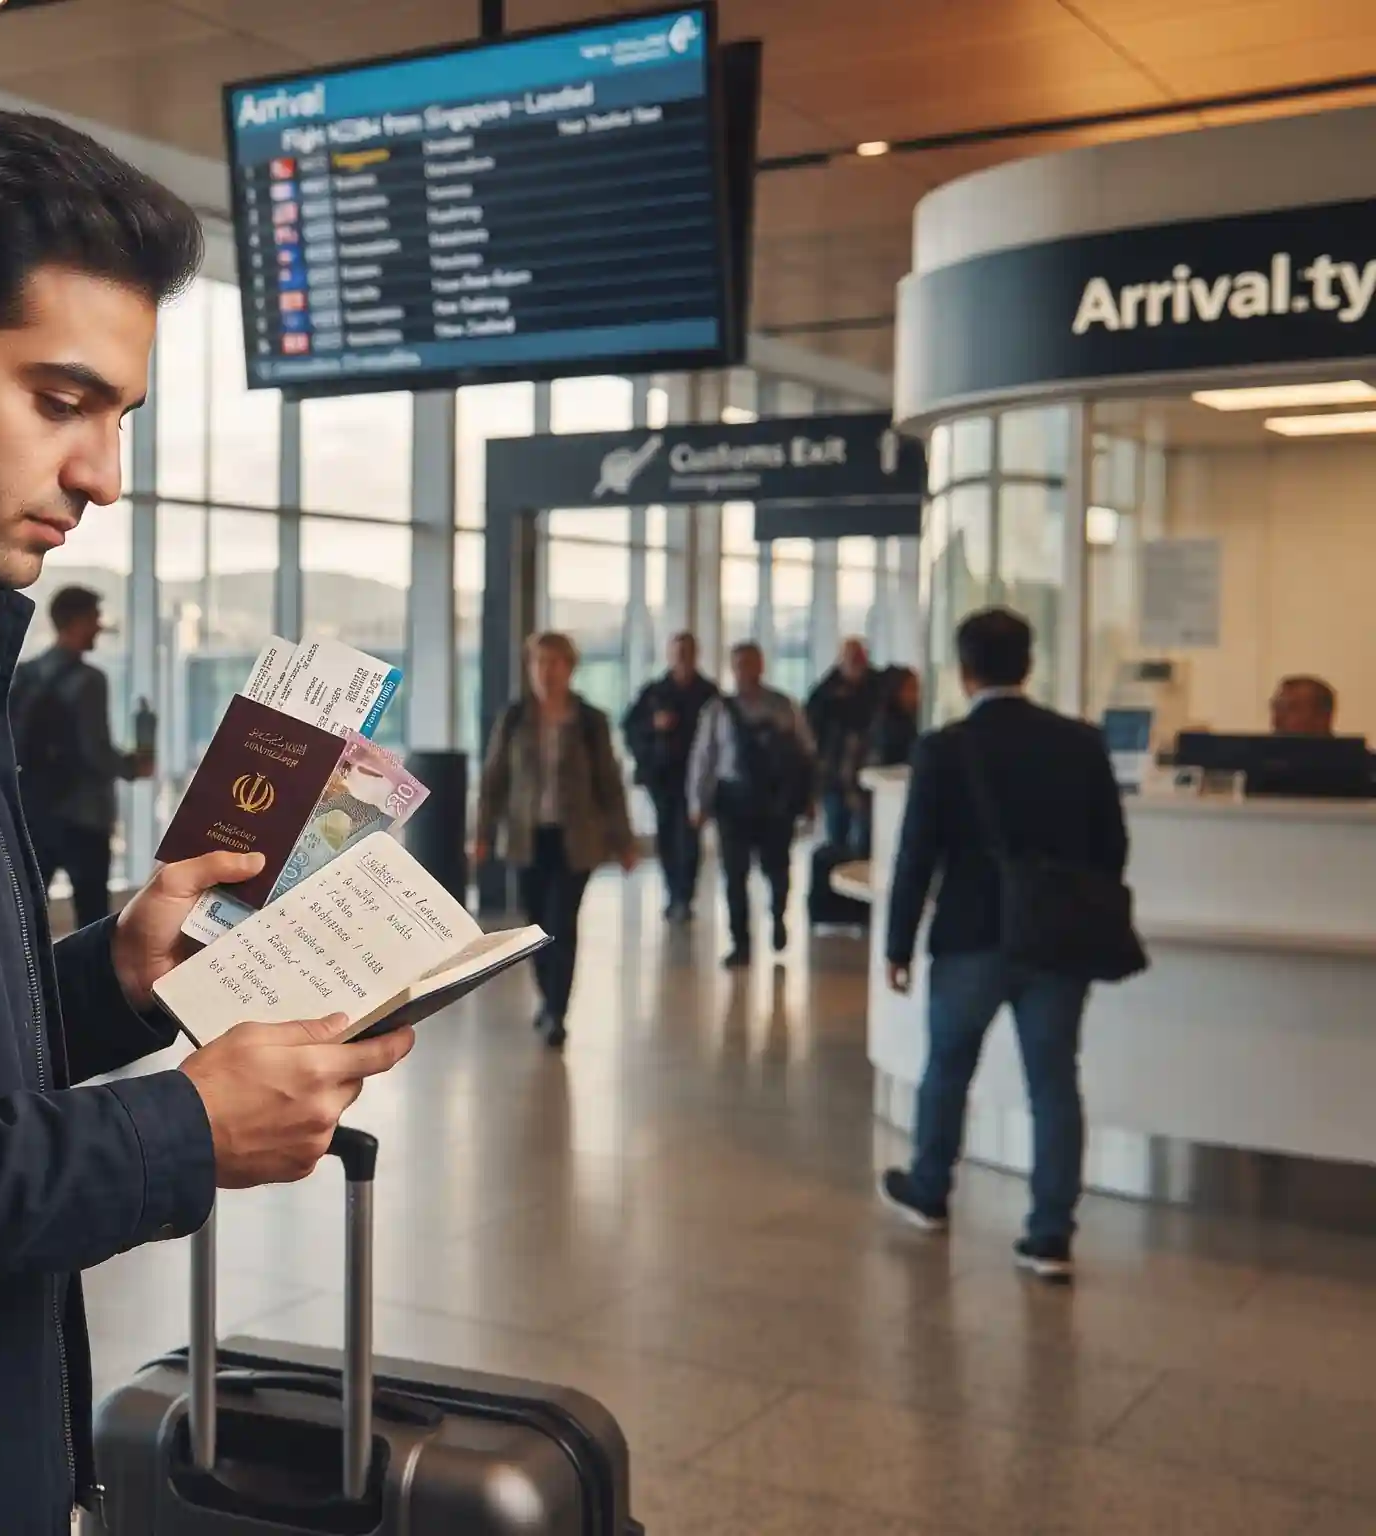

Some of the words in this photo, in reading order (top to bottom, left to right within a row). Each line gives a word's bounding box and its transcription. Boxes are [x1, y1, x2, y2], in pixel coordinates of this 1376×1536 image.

[238, 83, 325, 128] Arrival
[670, 443, 785, 473] Customs
[791, 436, 846, 467] Exit
